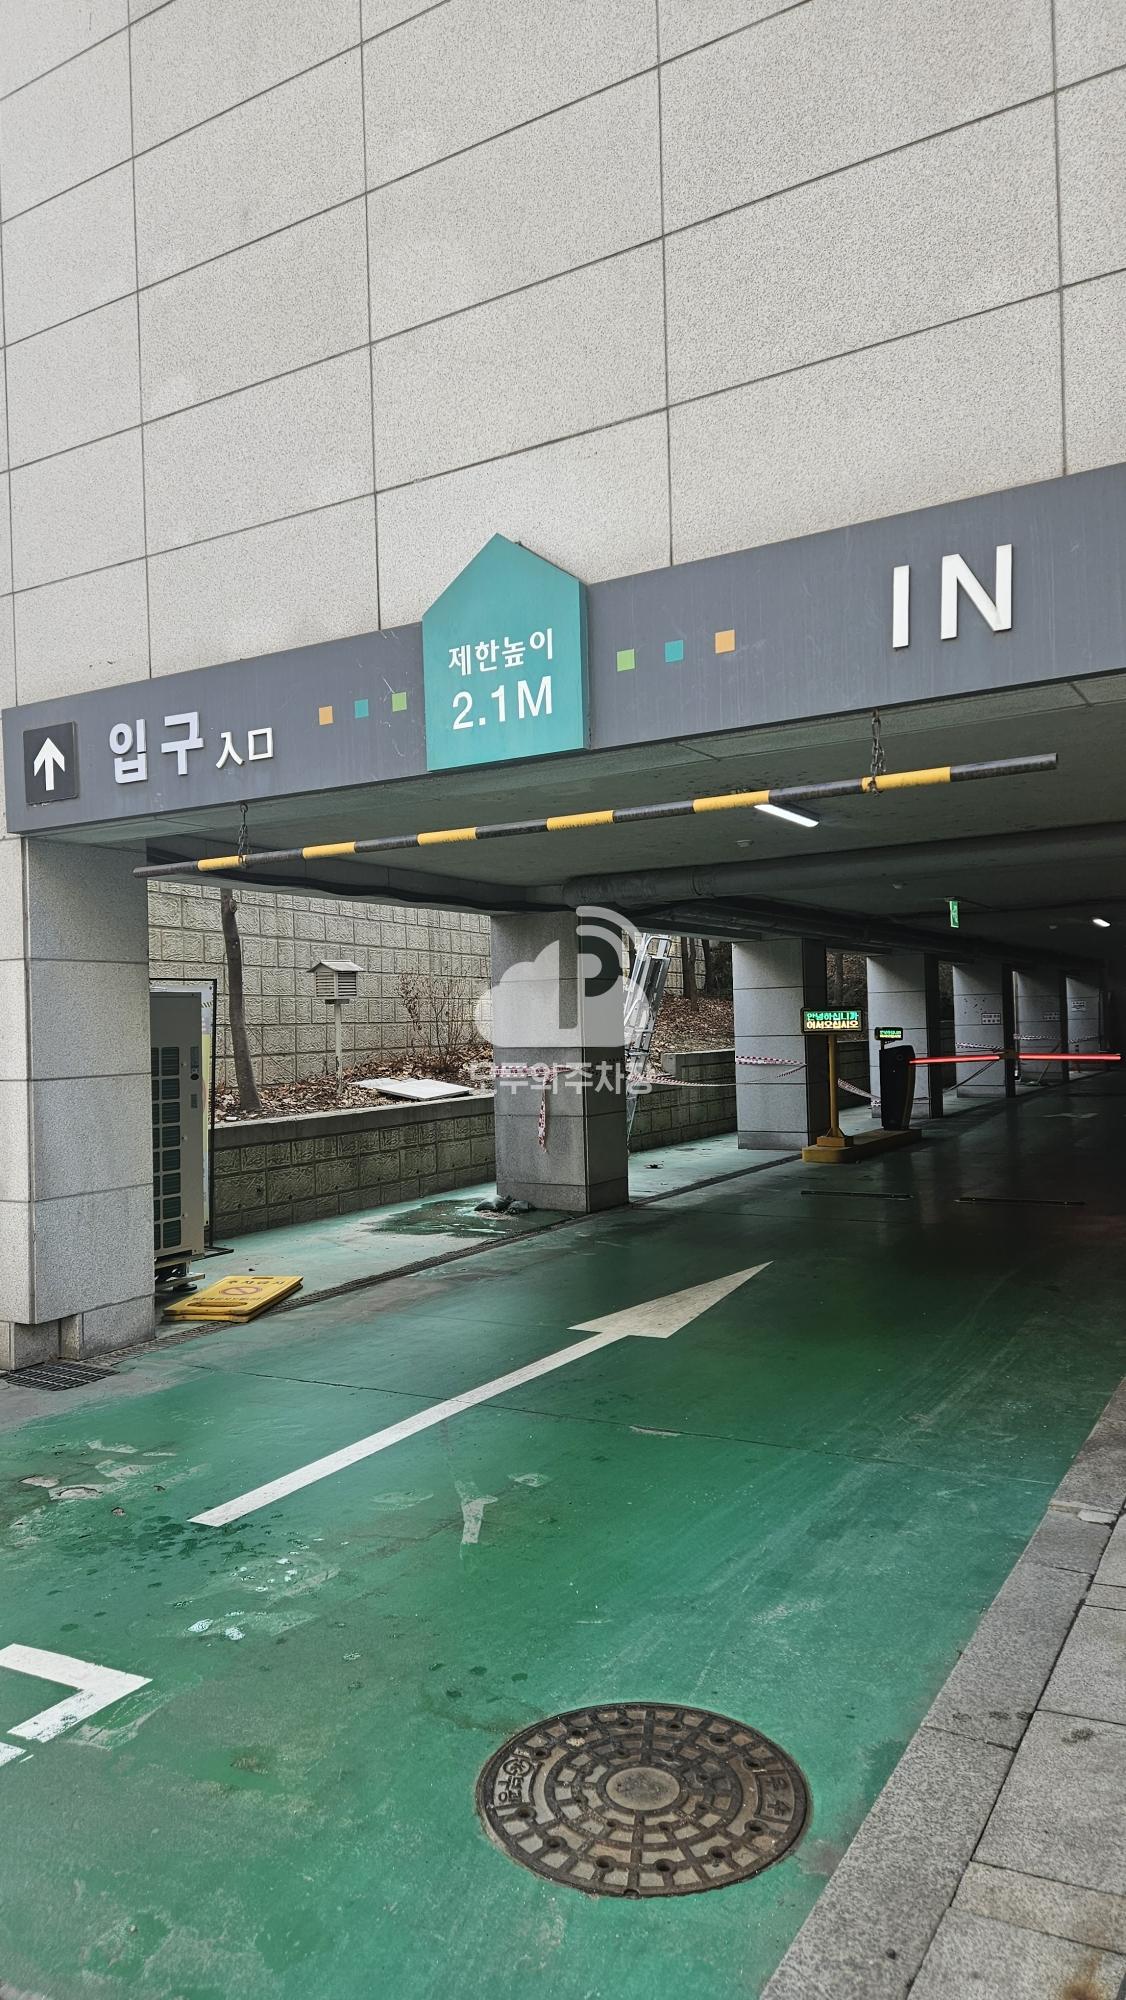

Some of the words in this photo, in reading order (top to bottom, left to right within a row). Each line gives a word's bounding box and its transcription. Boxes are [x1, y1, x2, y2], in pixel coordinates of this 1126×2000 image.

[892, 543, 1013, 648] IN
[448, 627, 553, 676] 제한높이
[452, 675, 553, 730] 2.1M
[109, 711, 205, 784] 입구
[215, 727, 274, 769] 入口
[806, 1011, 859, 1020] 안녕하십니까
[806, 1020, 859, 1029] 어서오십시오
